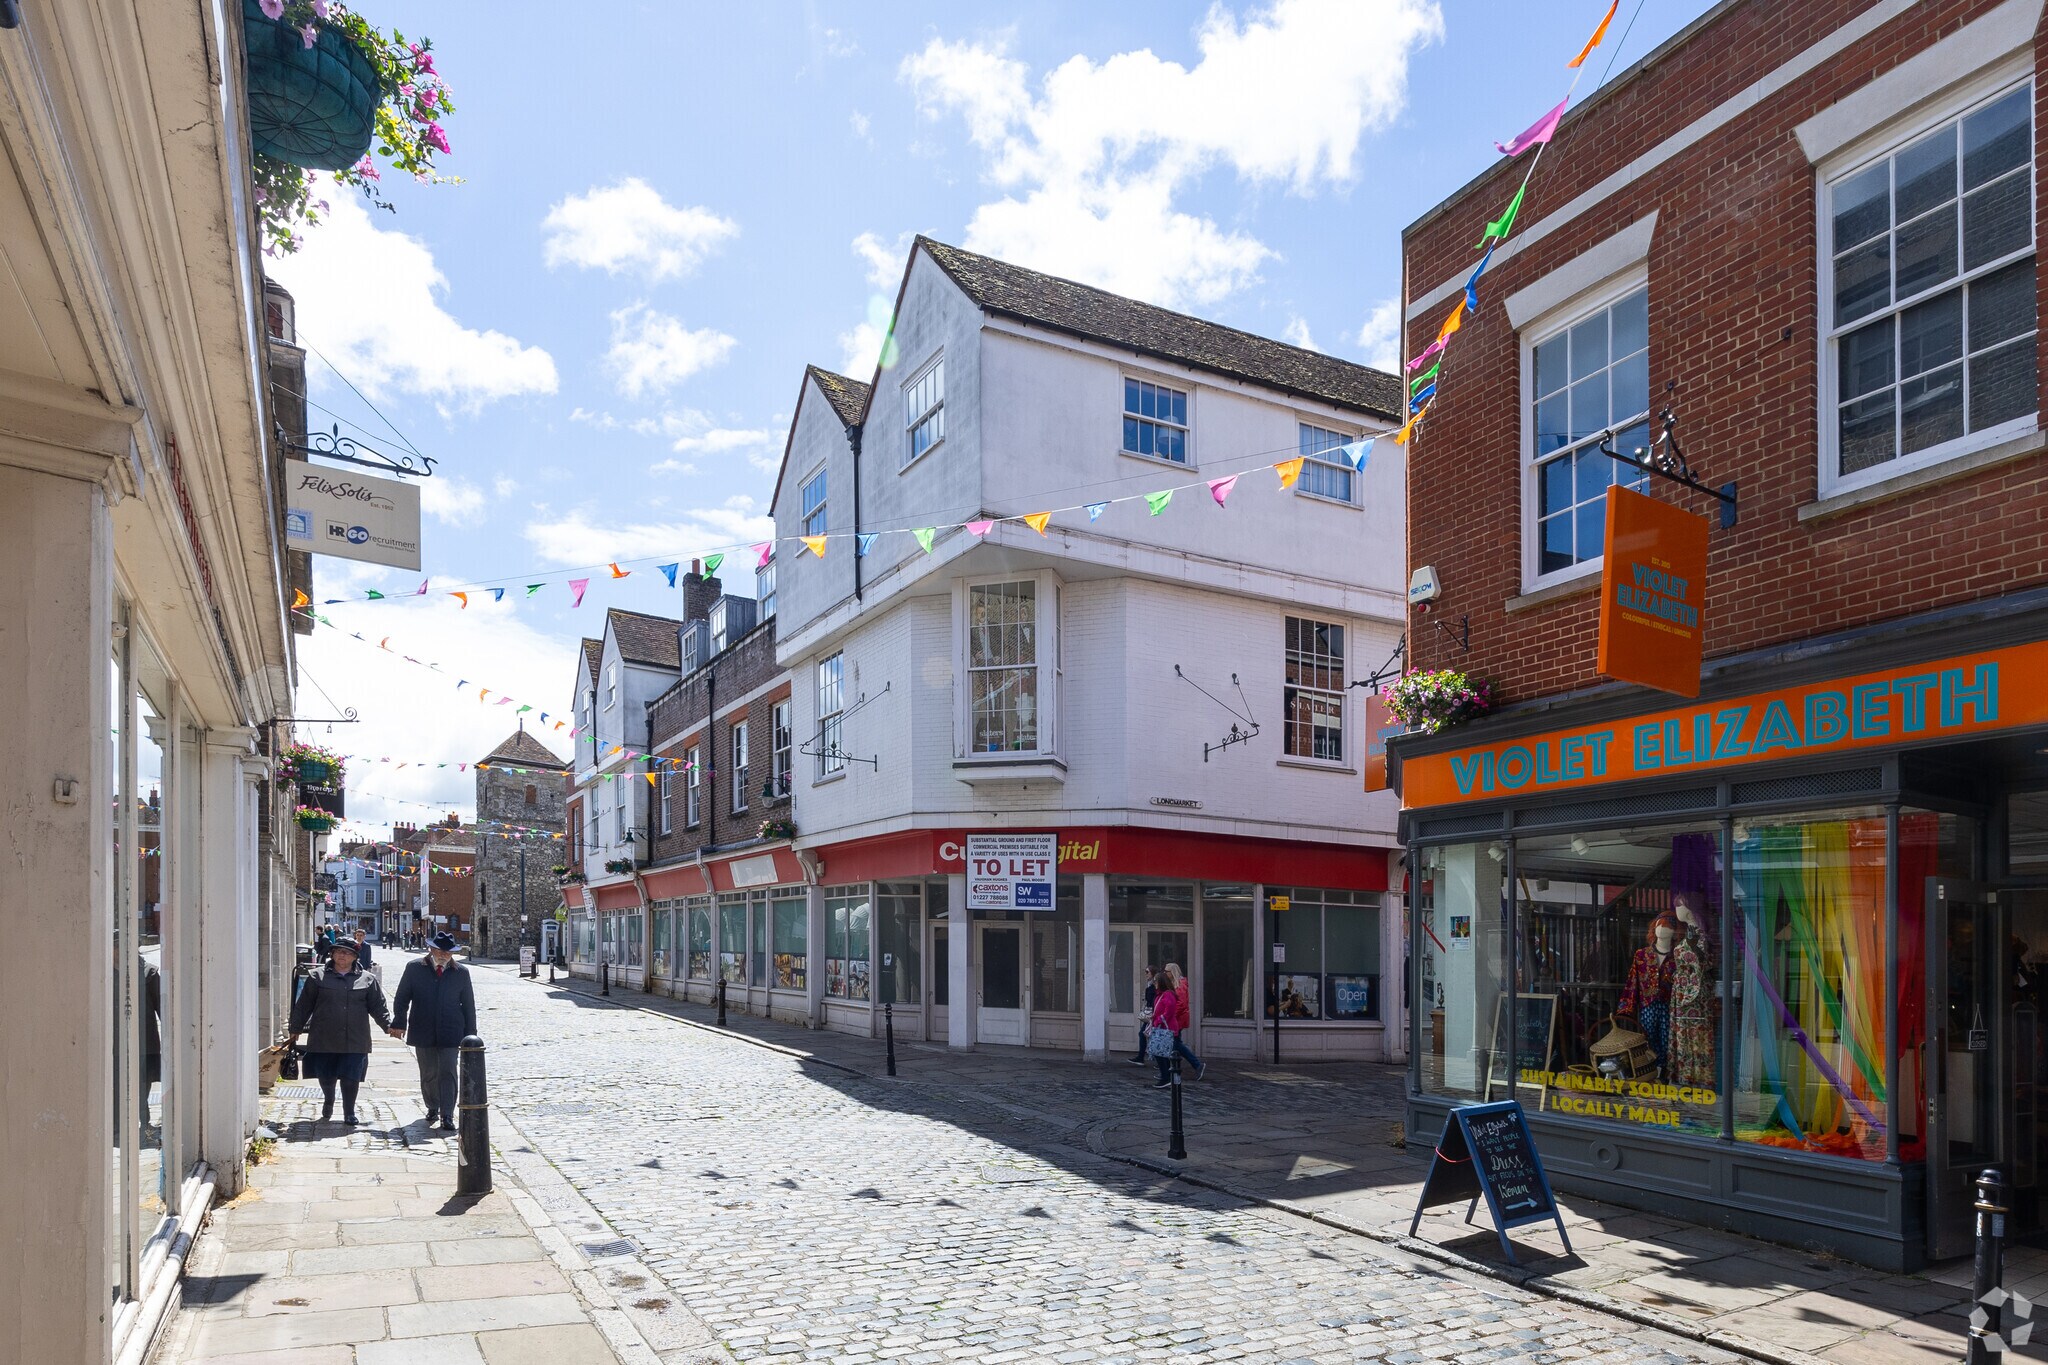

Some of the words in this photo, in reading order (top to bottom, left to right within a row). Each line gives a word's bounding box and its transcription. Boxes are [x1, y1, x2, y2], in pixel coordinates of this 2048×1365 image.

[329, 525, 345, 537] HR
[347, 529, 368, 541] GO
[369, 536, 416, 549] recruitment
[1632, 562, 1688, 600] VIOLET
[1617, 584, 1698, 628] ELIZABETH
[1449, 730, 1614, 795] VIOLET
[1634, 662, 1999, 772] ELIZABETH
[973, 859, 1002, 876] TO
[1009, 859, 1050, 876] LET
[1338, 988, 1366, 1003] Open
[1520, 1068, 1625, 1094] SUSTAINABLY
[1628, 1081, 1716, 1105] SOURCED
[1552, 1096, 1624, 1119] LOCALLY
[1629, 1108, 1680, 1127] MADE
[1503, 1132, 1520, 1141] PEOPLE
[1490, 1154, 1525, 1171] Dress
